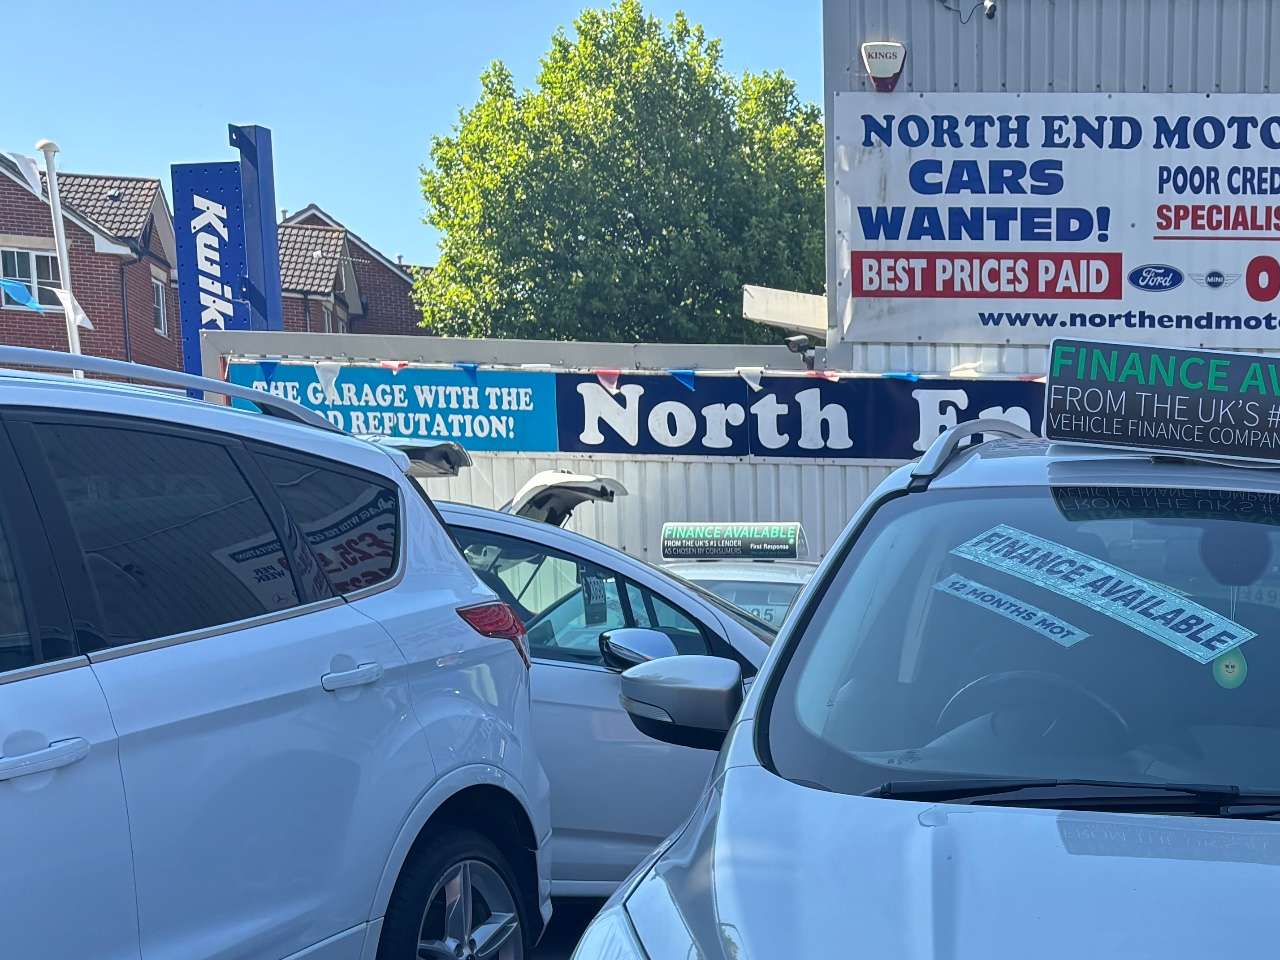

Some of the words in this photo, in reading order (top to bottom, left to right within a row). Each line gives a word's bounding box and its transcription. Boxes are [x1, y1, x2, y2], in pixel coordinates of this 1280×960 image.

[867, 51, 898, 60] KINGS
[861, 114, 1030, 148] NORTH
[1042, 115, 1142, 150] END
[909, 159, 1065, 195] CARS
[1158, 166, 1219, 195] POOR
[857, 206, 1111, 242] WANTED!
[191, 194, 234, 330] Kwik
[862, 258, 927, 292] BEST
[936, 258, 1028, 293] PRICES
[1038, 259, 1110, 294] PAID
[1052, 345, 1231, 392] FINANCE
[307, 382, 408, 407] GARAGE
[414, 385, 479, 410] WITH
[484, 387, 534, 411] THE
[1050, 385, 1126, 415] FROM
[1136, 392, 1189, 421] THE
[1198, 398, 1260, 427] UK'S
[351, 411, 514, 439] REPUTATION!
[577, 383, 853, 450] North
[1050, 412, 1123, 435] VEHICLE
[1128, 419, 1204, 442] FINANCE
[664, 526, 721, 538] FINANCE
[724, 526, 795, 538] AVAILABLE
[664, 539, 681, 547] FROM
[682, 539, 694, 547] THE
[763, 543, 789, 551] Response
[972, 531, 1093, 584] FINANCE
[1082, 574, 1238, 651] AVAILABLE
[966, 588, 1034, 622] MONTHS
[1034, 616, 1076, 641] MOT
